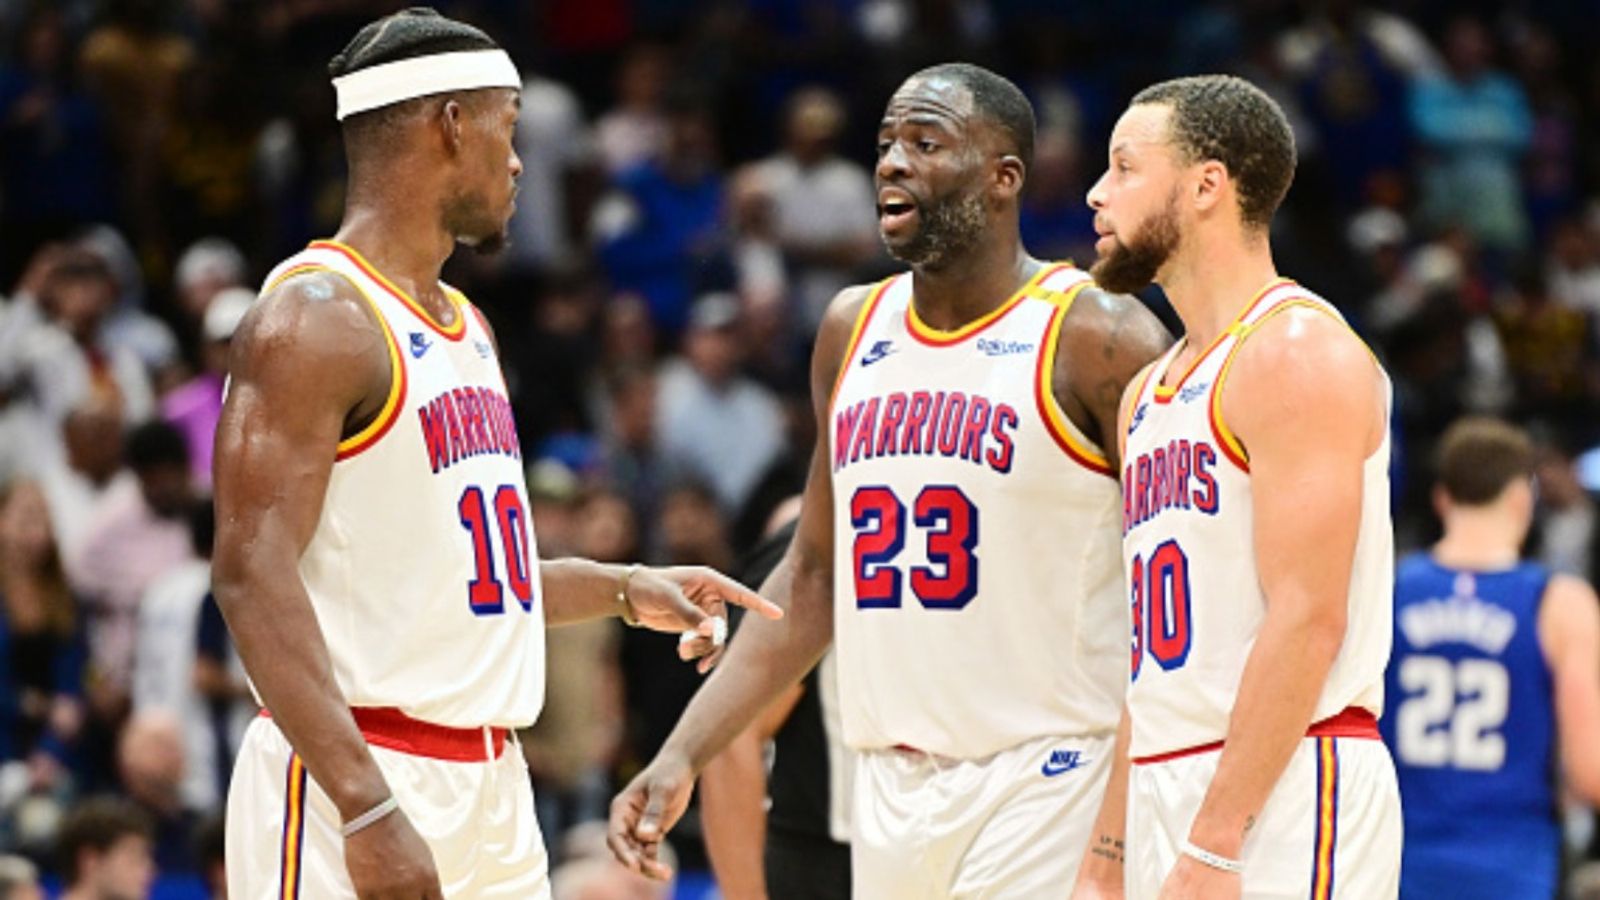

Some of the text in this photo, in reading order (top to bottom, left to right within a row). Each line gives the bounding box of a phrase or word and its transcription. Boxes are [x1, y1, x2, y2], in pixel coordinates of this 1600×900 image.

[834, 390, 1019, 474] WARRIORS
[458, 484, 534, 616] 10
[850, 484, 979, 611] 23
[1397, 654, 1510, 772] 22
